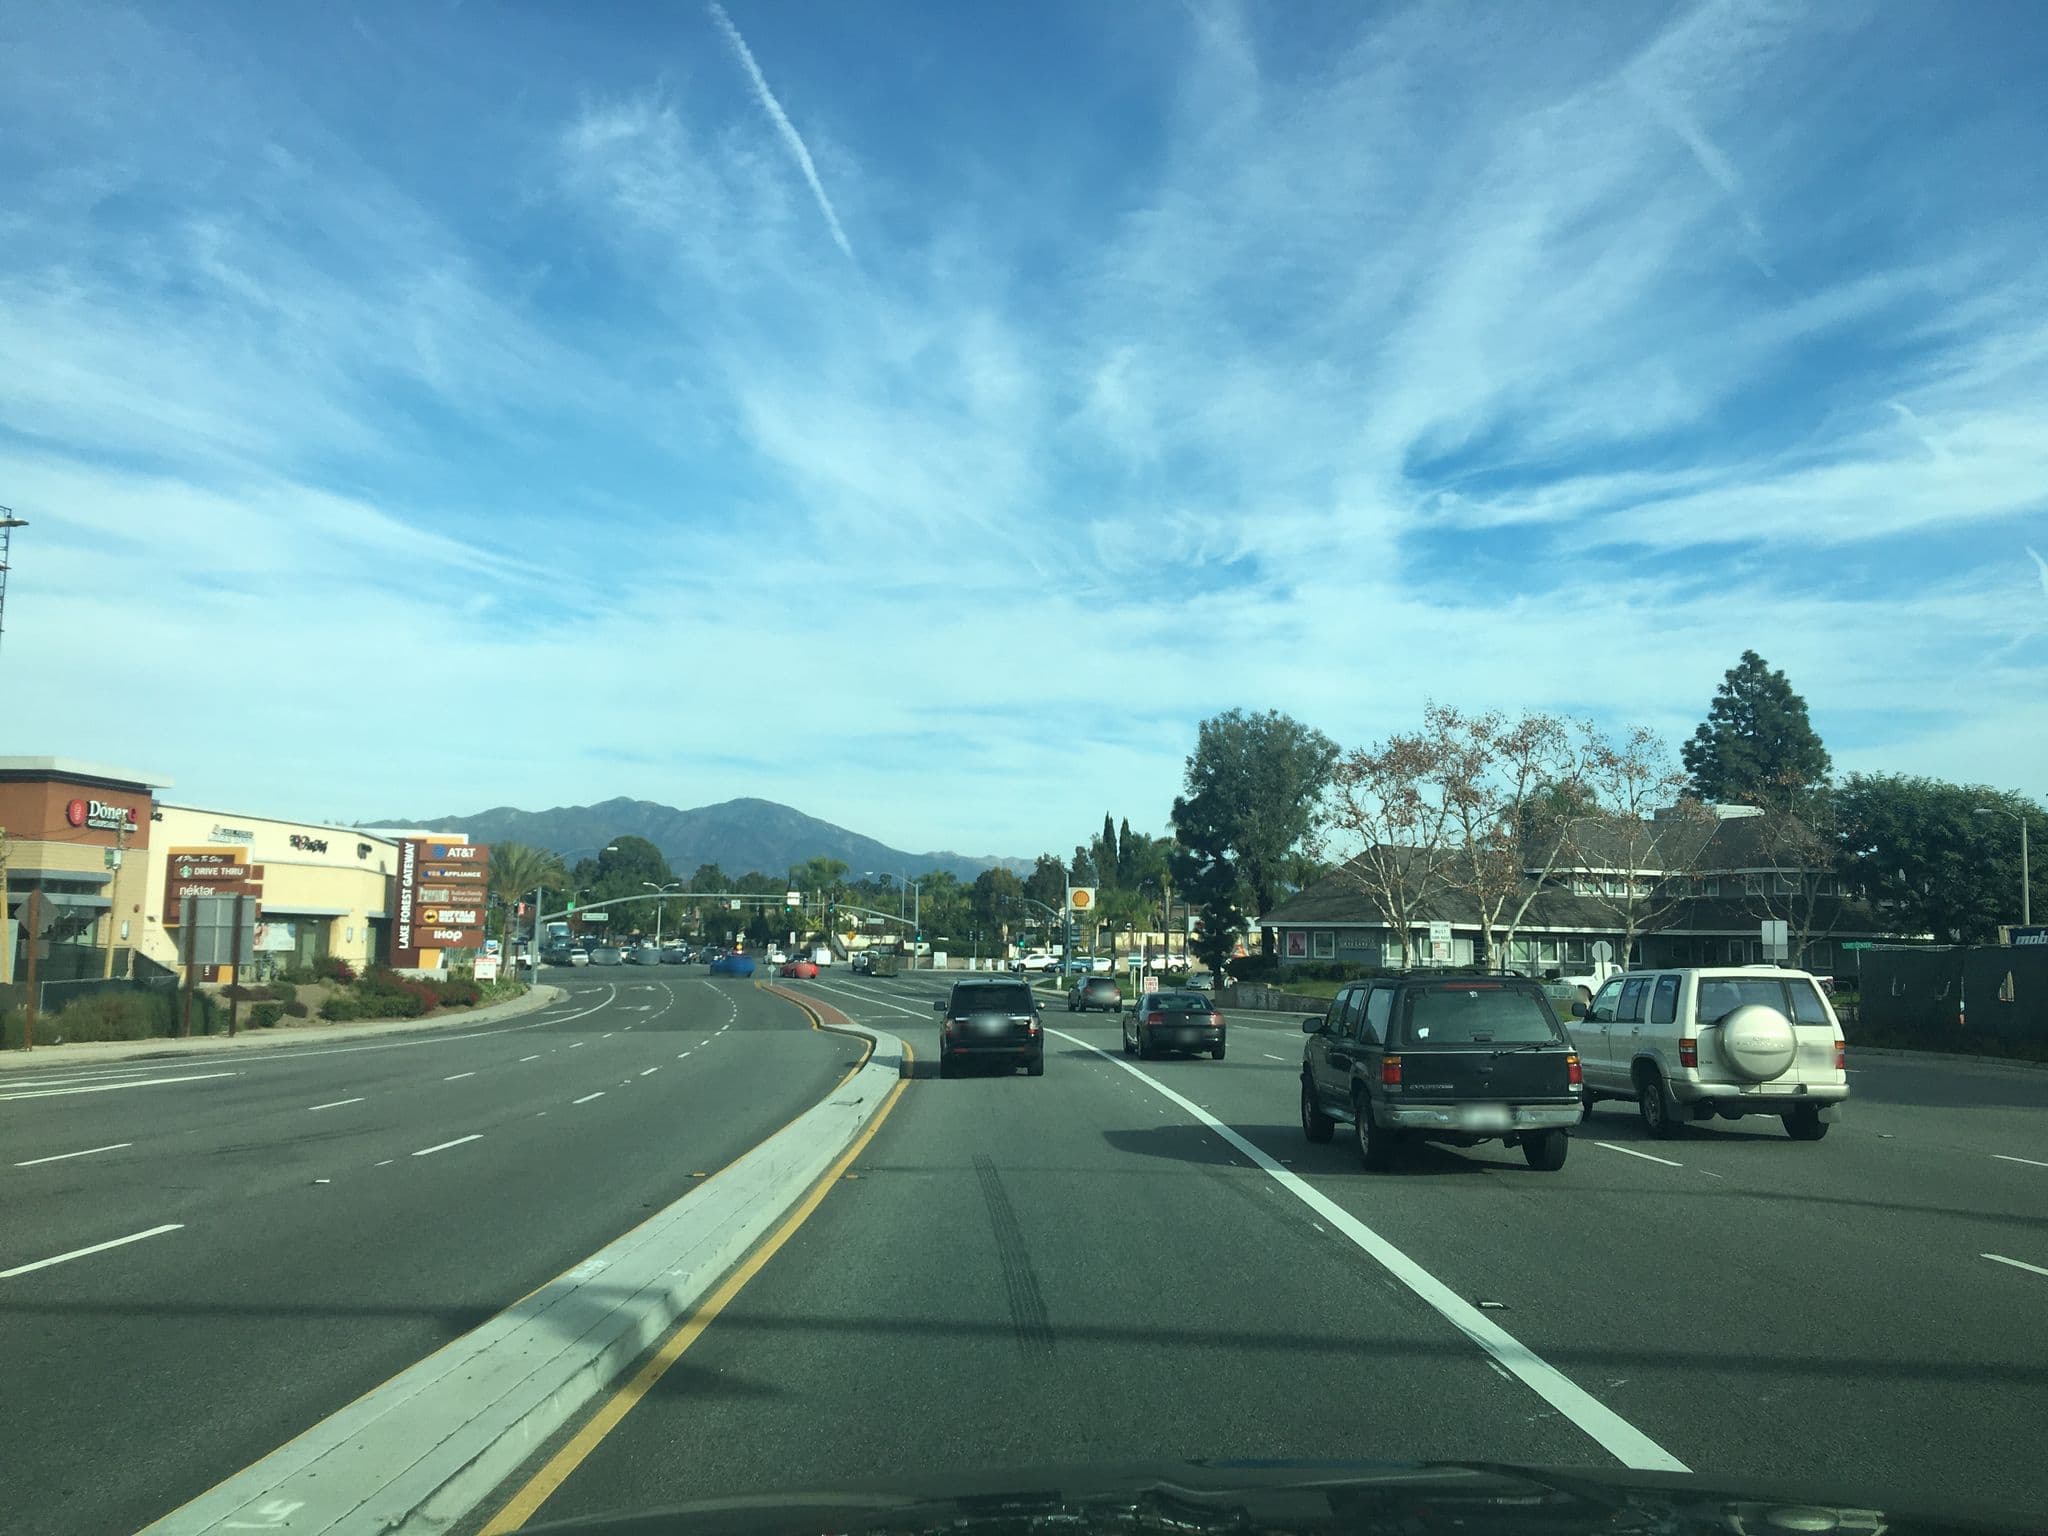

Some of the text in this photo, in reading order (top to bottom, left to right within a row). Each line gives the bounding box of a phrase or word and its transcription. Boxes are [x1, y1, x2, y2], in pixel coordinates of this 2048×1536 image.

[447, 847, 476, 858] AT&T
[194, 867, 243, 876] DRIVE THRU
[398, 842, 415, 949] LAKE FOREST GATEWAY
